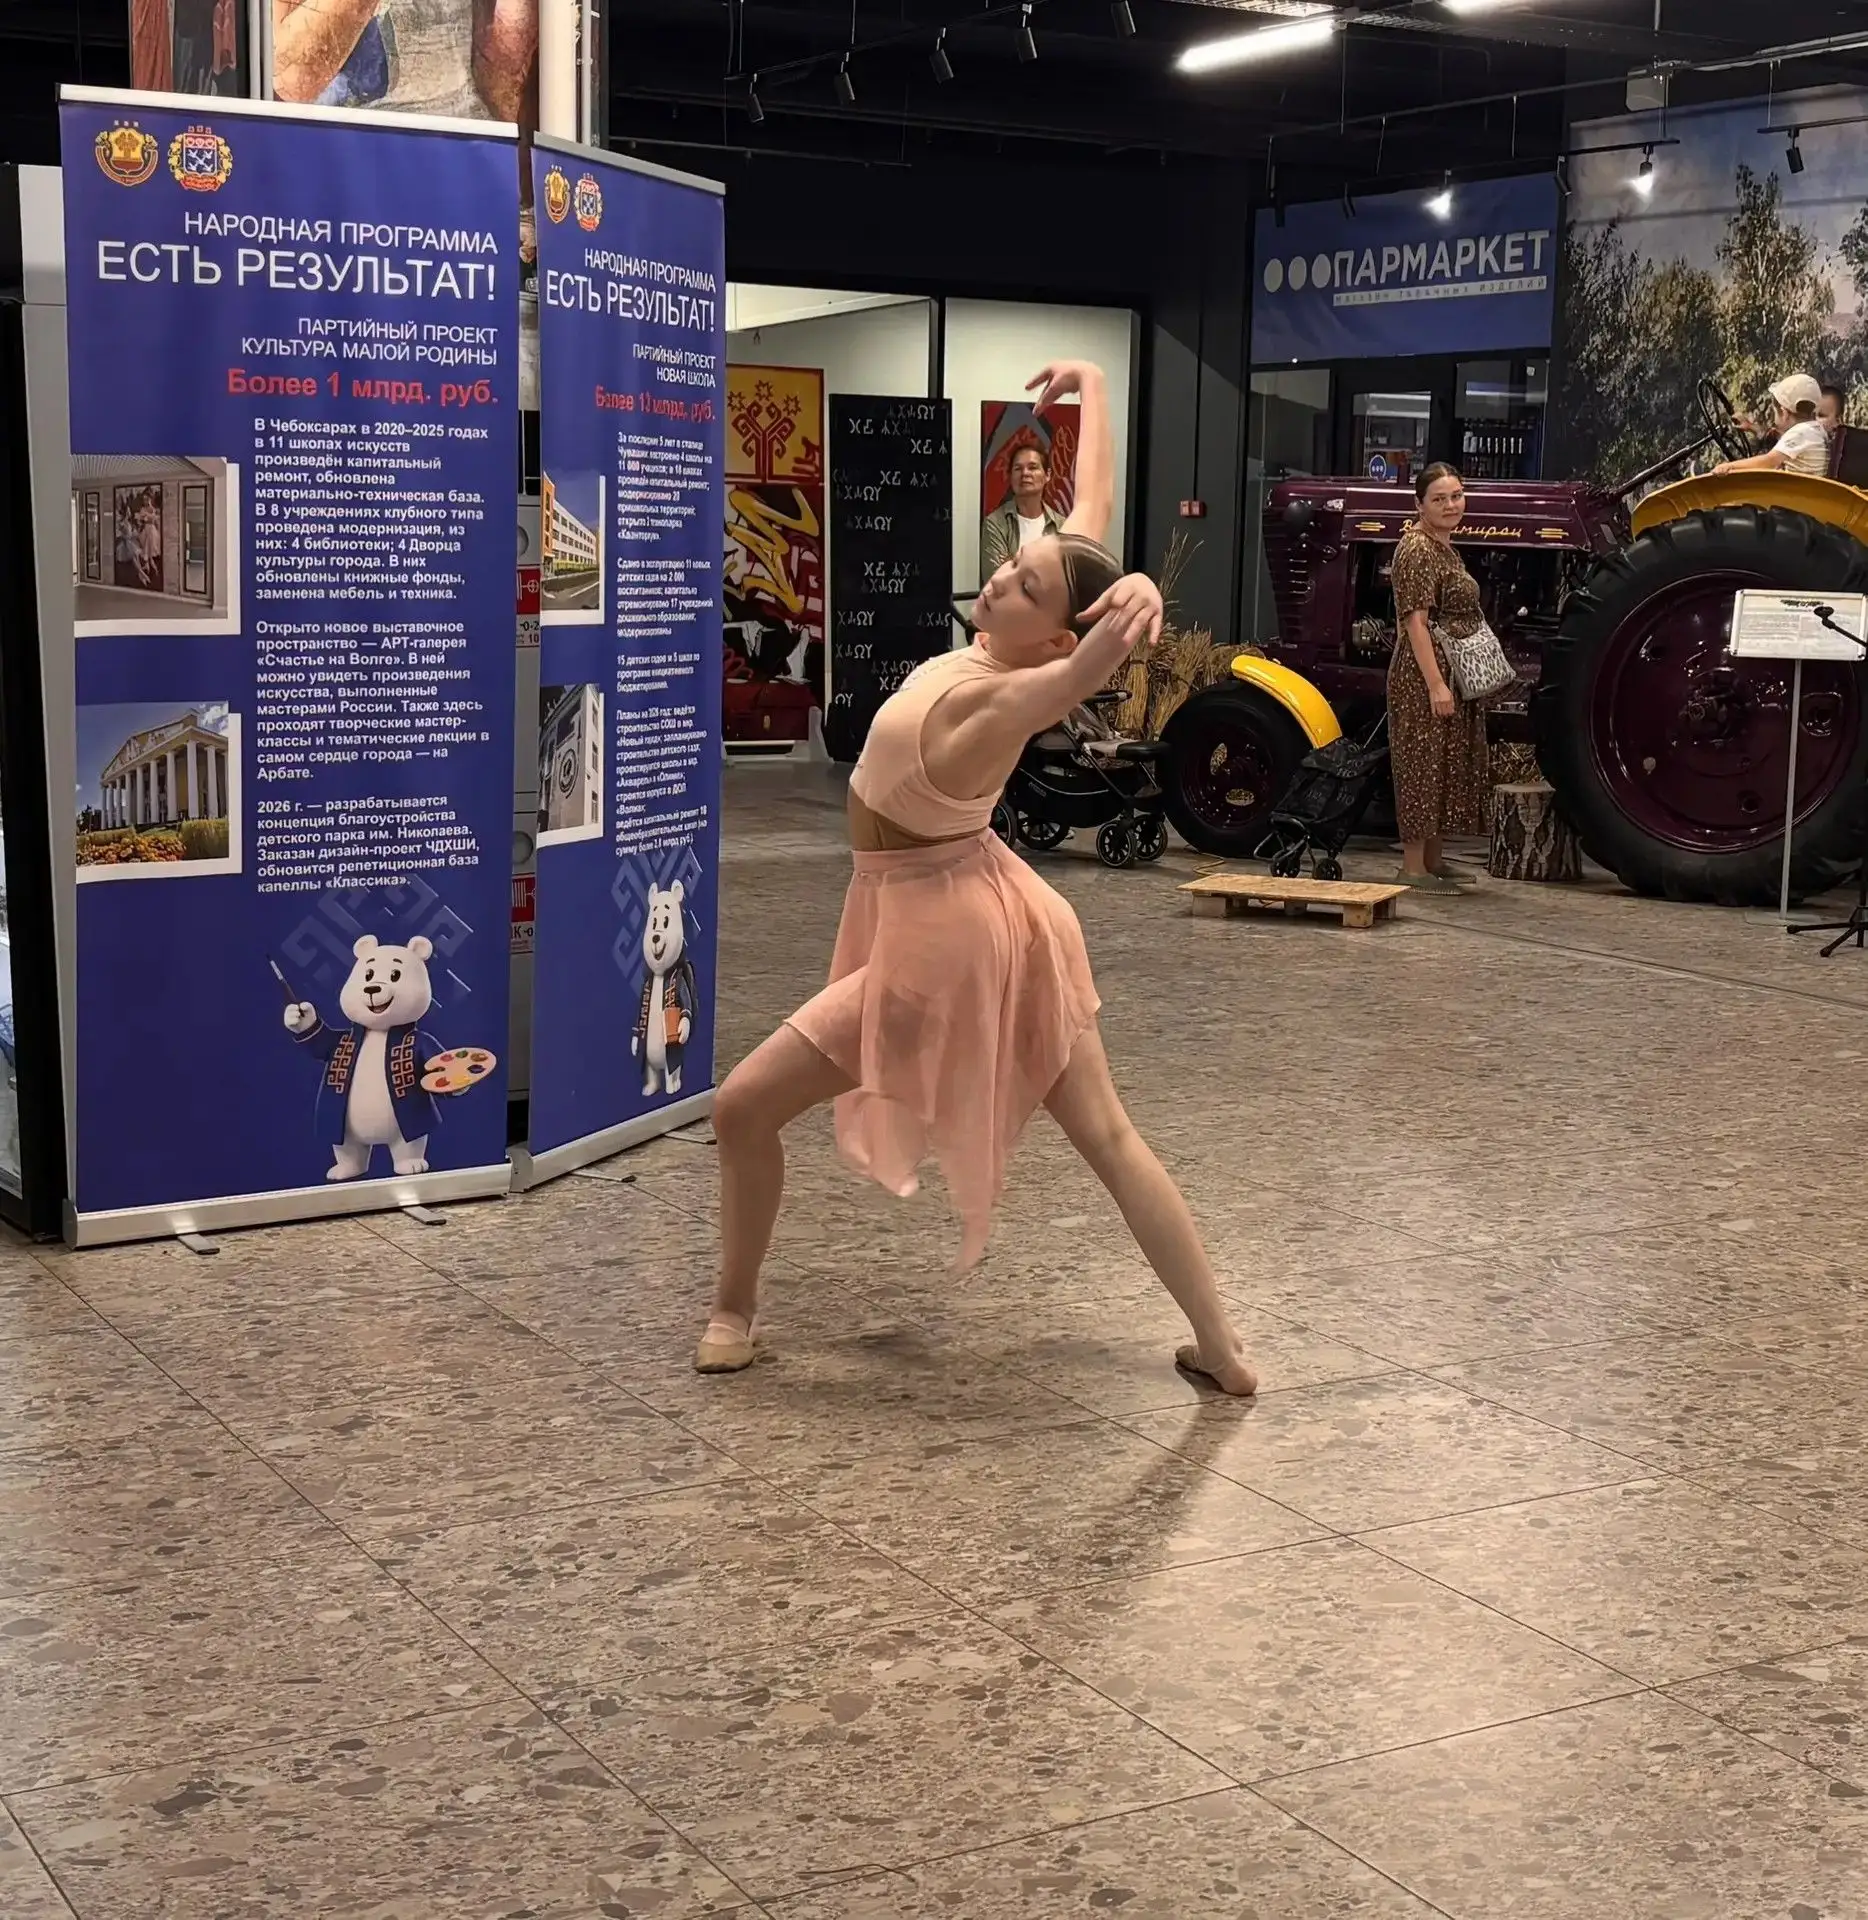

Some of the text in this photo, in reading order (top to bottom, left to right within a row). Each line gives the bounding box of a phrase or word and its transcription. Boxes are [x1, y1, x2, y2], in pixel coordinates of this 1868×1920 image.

[185, 212, 498, 254] НАРОДНАЯ ПРОГРАММА
[1333, 230, 1550, 288] ПАРМАРКЕТ
[98, 240, 495, 300] ЕСТЬ РЕЗУЛЬТАТ!
[585, 248, 716, 293] НАРОДНАЯ ПРОГРАММА
[547, 269, 714, 332] ЕСТЬ РЕЗУЛЬТАТ!
[299, 318, 498, 344] ПАРТИЙНЫЙ ПРОЕКТ
[242, 337, 497, 367] КУЛЬТУРА МАЛОЙ РОДИНЫ
[633, 343, 716, 369] ПАРТИЙНЫЙ ПРОЕКТ
[657, 367, 716, 388] НОВАЯ ШКОЛА
[227, 368, 497, 407] Более 1 млрд. руб.
[255, 418, 488, 440] В Чебоксарах в 2020–2025 годах
[255, 435, 410, 455] в 11 школах искусств
[255, 454, 441, 469] произведён капитальный
[255, 470, 395, 485] ремонт, обновлена
[255, 488, 484, 503] материально-техническая база.
[255, 503, 483, 522] В 8 учреждениях клубного типа
[256, 523, 465, 537] проведена модернизация, из
[256, 537, 461, 554] них: 4 библиотеки; 4 Дворца
[256, 554, 426, 569] культуры города. В них
[256, 570, 465, 586] обновлены книжные фонды,
[256, 586, 457, 599] заменена мебель и техника.
[256, 621, 464, 636] Открыто новое выставочное
[257, 639, 358, 653] пространство
[381, 636, 466, 651] АРТ-галерея
[257, 652, 445, 666] «Счастье на Волге». В ней
[257, 670, 470, 685] можно увидеть произведения
[257, 686, 438, 701] искусства, выполненные
[257, 700, 483, 717] мастерами России. Также здесь
[257, 717, 466, 734] проходят творческие мастер-
[257, 732, 489, 747] классы и тематические лекции в
[257, 753, 304, 763] самом
[308, 751, 359, 764] сердце
[363, 750, 412, 762] города
[433, 748, 448, 758] на
[257, 766, 314, 782] Арбате.
[257, 800, 291, 813] 2026
[295, 803, 303, 812] г.
[326, 796, 447, 813] разрабатывается
[258, 811, 456, 829] концепция благоустройства
[257, 826, 472, 847] детского парка им. Николаева.
[258, 849, 315, 861] Заказан
[318, 844, 422, 860] дизайн-проект
[258, 854, 479, 877] обновится репетиционная база
[258, 876, 411, 892] капеллы «Классика».
